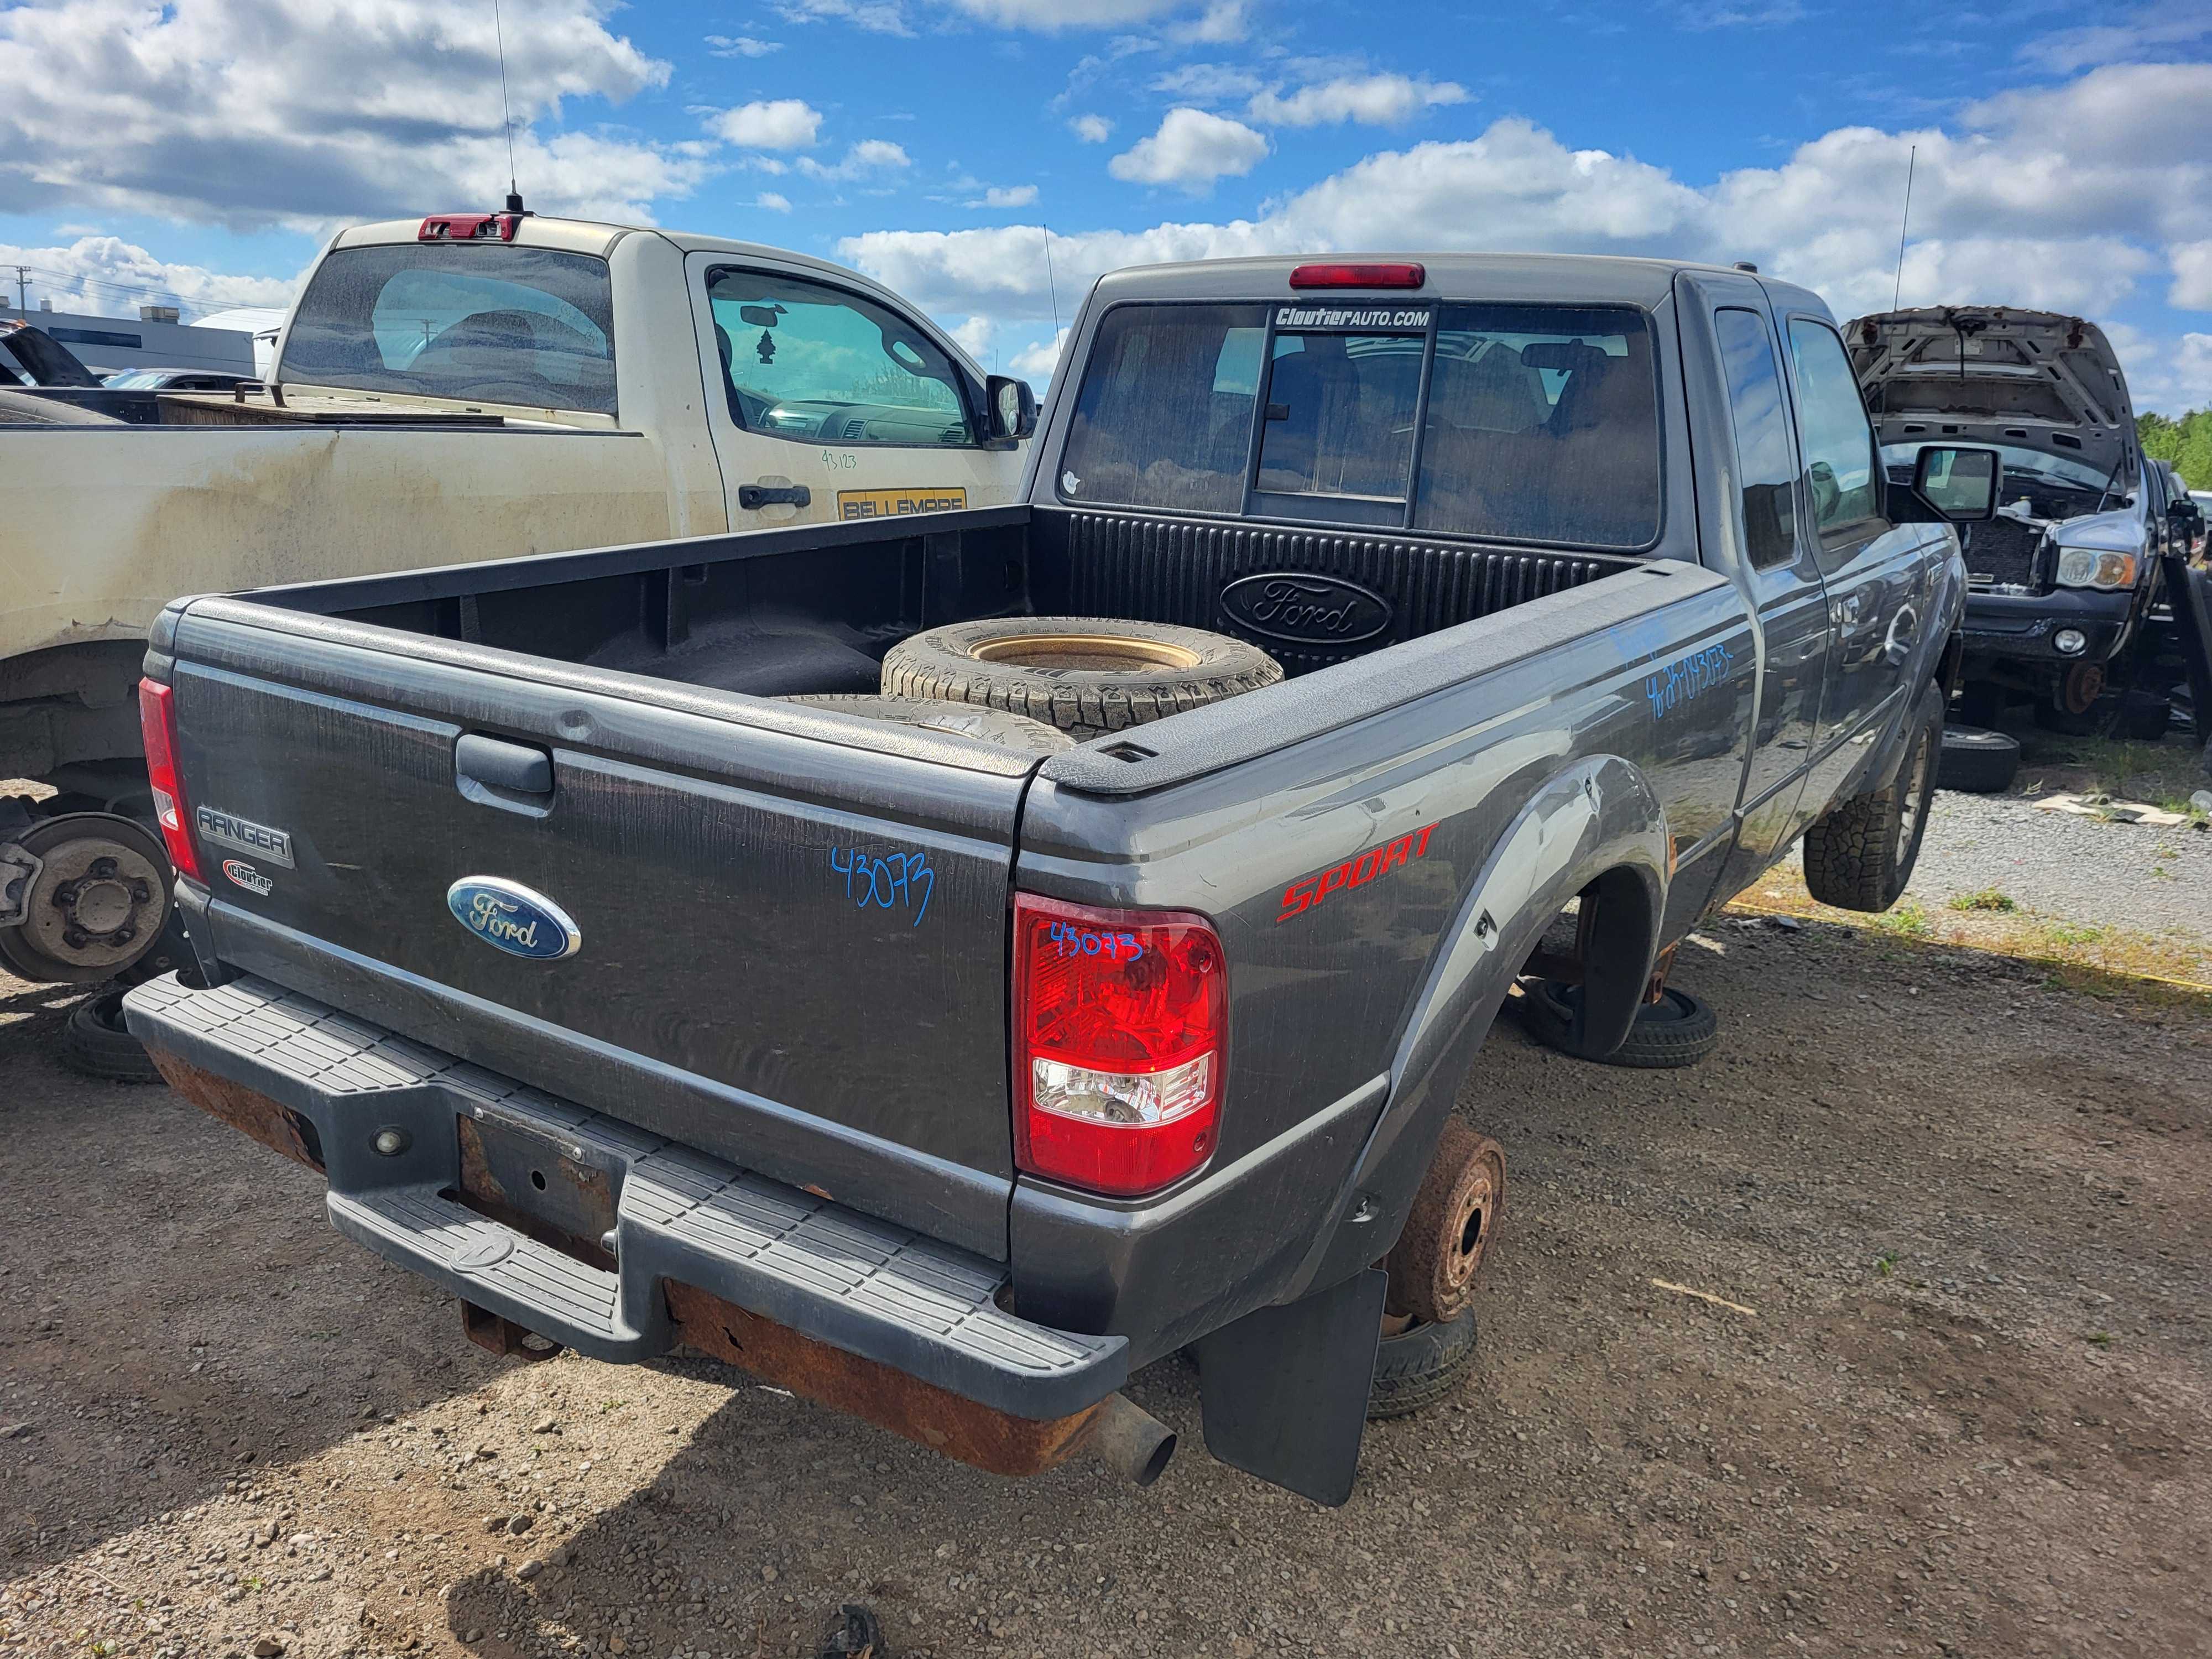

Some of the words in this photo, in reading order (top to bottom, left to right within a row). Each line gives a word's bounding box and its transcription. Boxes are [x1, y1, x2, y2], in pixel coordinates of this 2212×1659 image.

[822, 449, 857, 471] 43123
[1253, 580, 1358, 633] Ford
[199, 810, 286, 855] RANGER
[229, 863, 273, 891] Cloutier
[831, 847, 935, 927] 43073
[1275, 821, 1442, 923] SPORT
[469, 893, 538, 948] Ford
[1050, 922, 1144, 962] 43073
